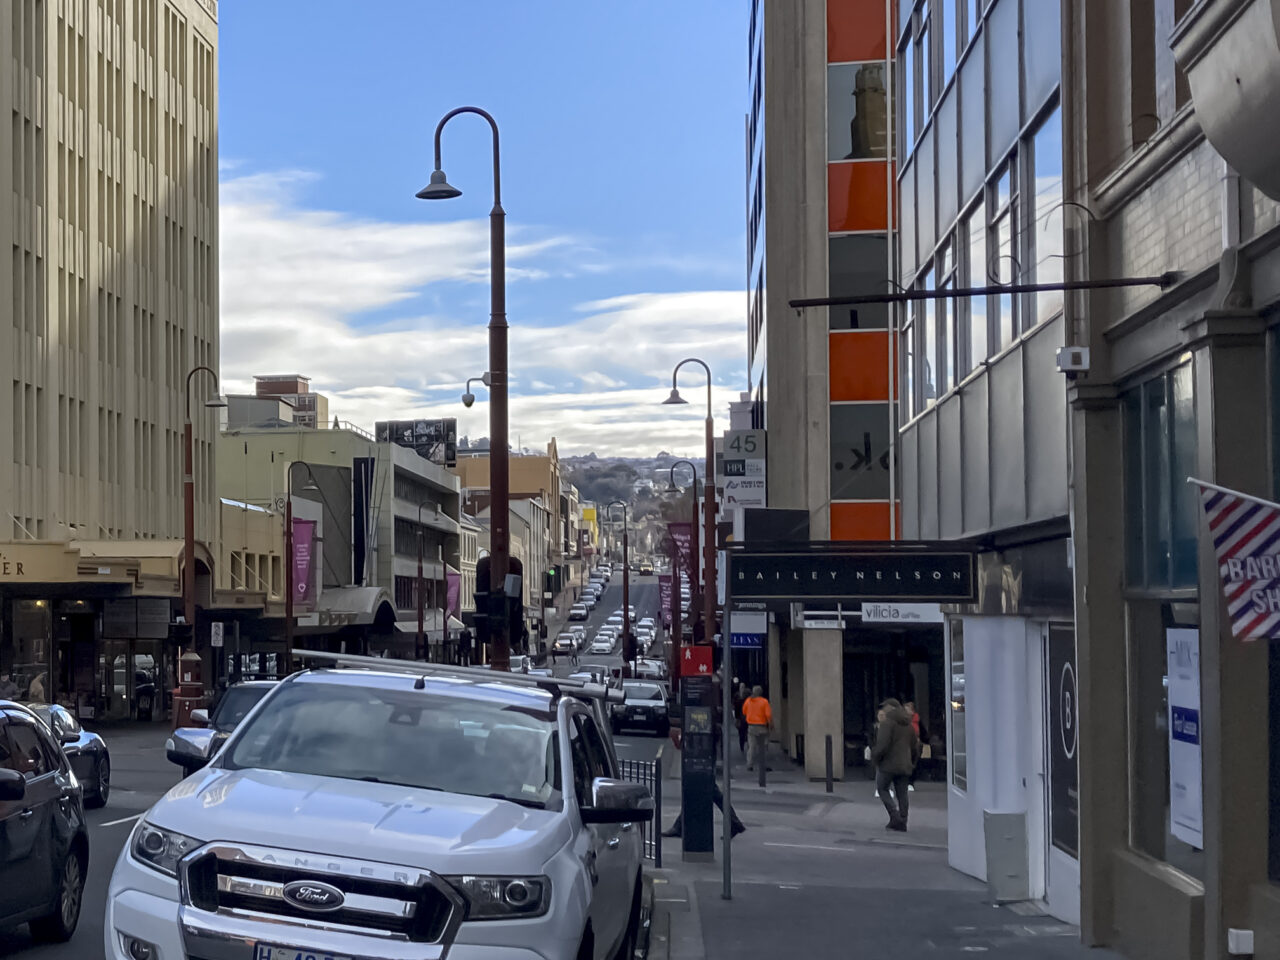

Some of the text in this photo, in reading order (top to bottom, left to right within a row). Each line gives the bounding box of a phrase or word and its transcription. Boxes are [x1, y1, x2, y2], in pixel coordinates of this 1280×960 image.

[729, 435, 757, 453] 45
[1227, 551, 1280, 583] BAR
[738, 571, 961, 580] BAILEY NELSON
[866, 605, 900, 620] vilicia
[295, 886, 329, 901] Ford
